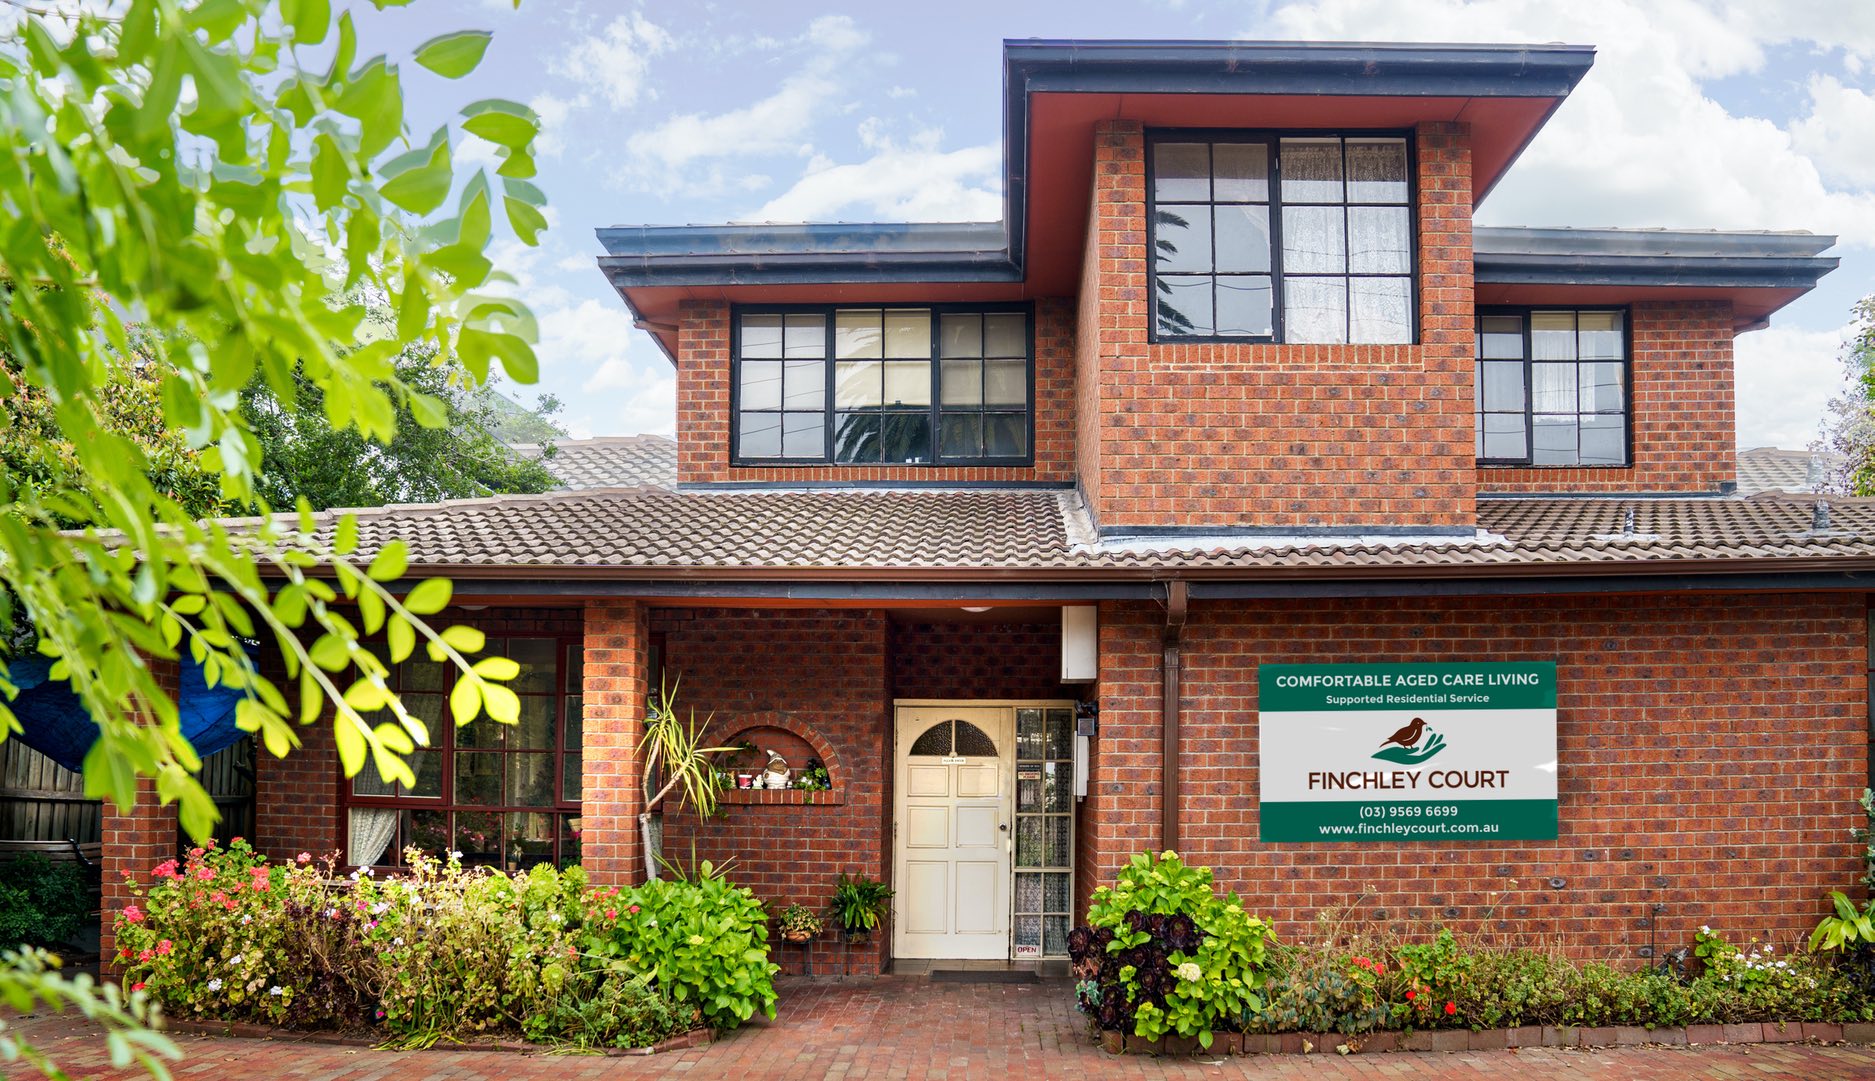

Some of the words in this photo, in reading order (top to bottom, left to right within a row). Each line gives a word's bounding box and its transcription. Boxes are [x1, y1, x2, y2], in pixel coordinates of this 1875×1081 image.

[1276, 674, 1391, 688] COMFORTABLE
[1395, 674, 1438, 687] AGED
[1442, 673, 1484, 686] CARE
[1488, 673, 1539, 686] LIVING
[1326, 694, 1383, 705] Supported
[1386, 694, 1447, 704] Residential
[1450, 693, 1490, 703] Service
[1308, 771, 1422, 790] FINCHLEY
[1428, 770, 1510, 789] COURT
[1359, 806, 1386, 818] (03)
[1389, 806, 1422, 817] 9569
[1425, 805, 1458, 817] 6699
[1318, 822, 1499, 836] www.finchleycourt.com.au
